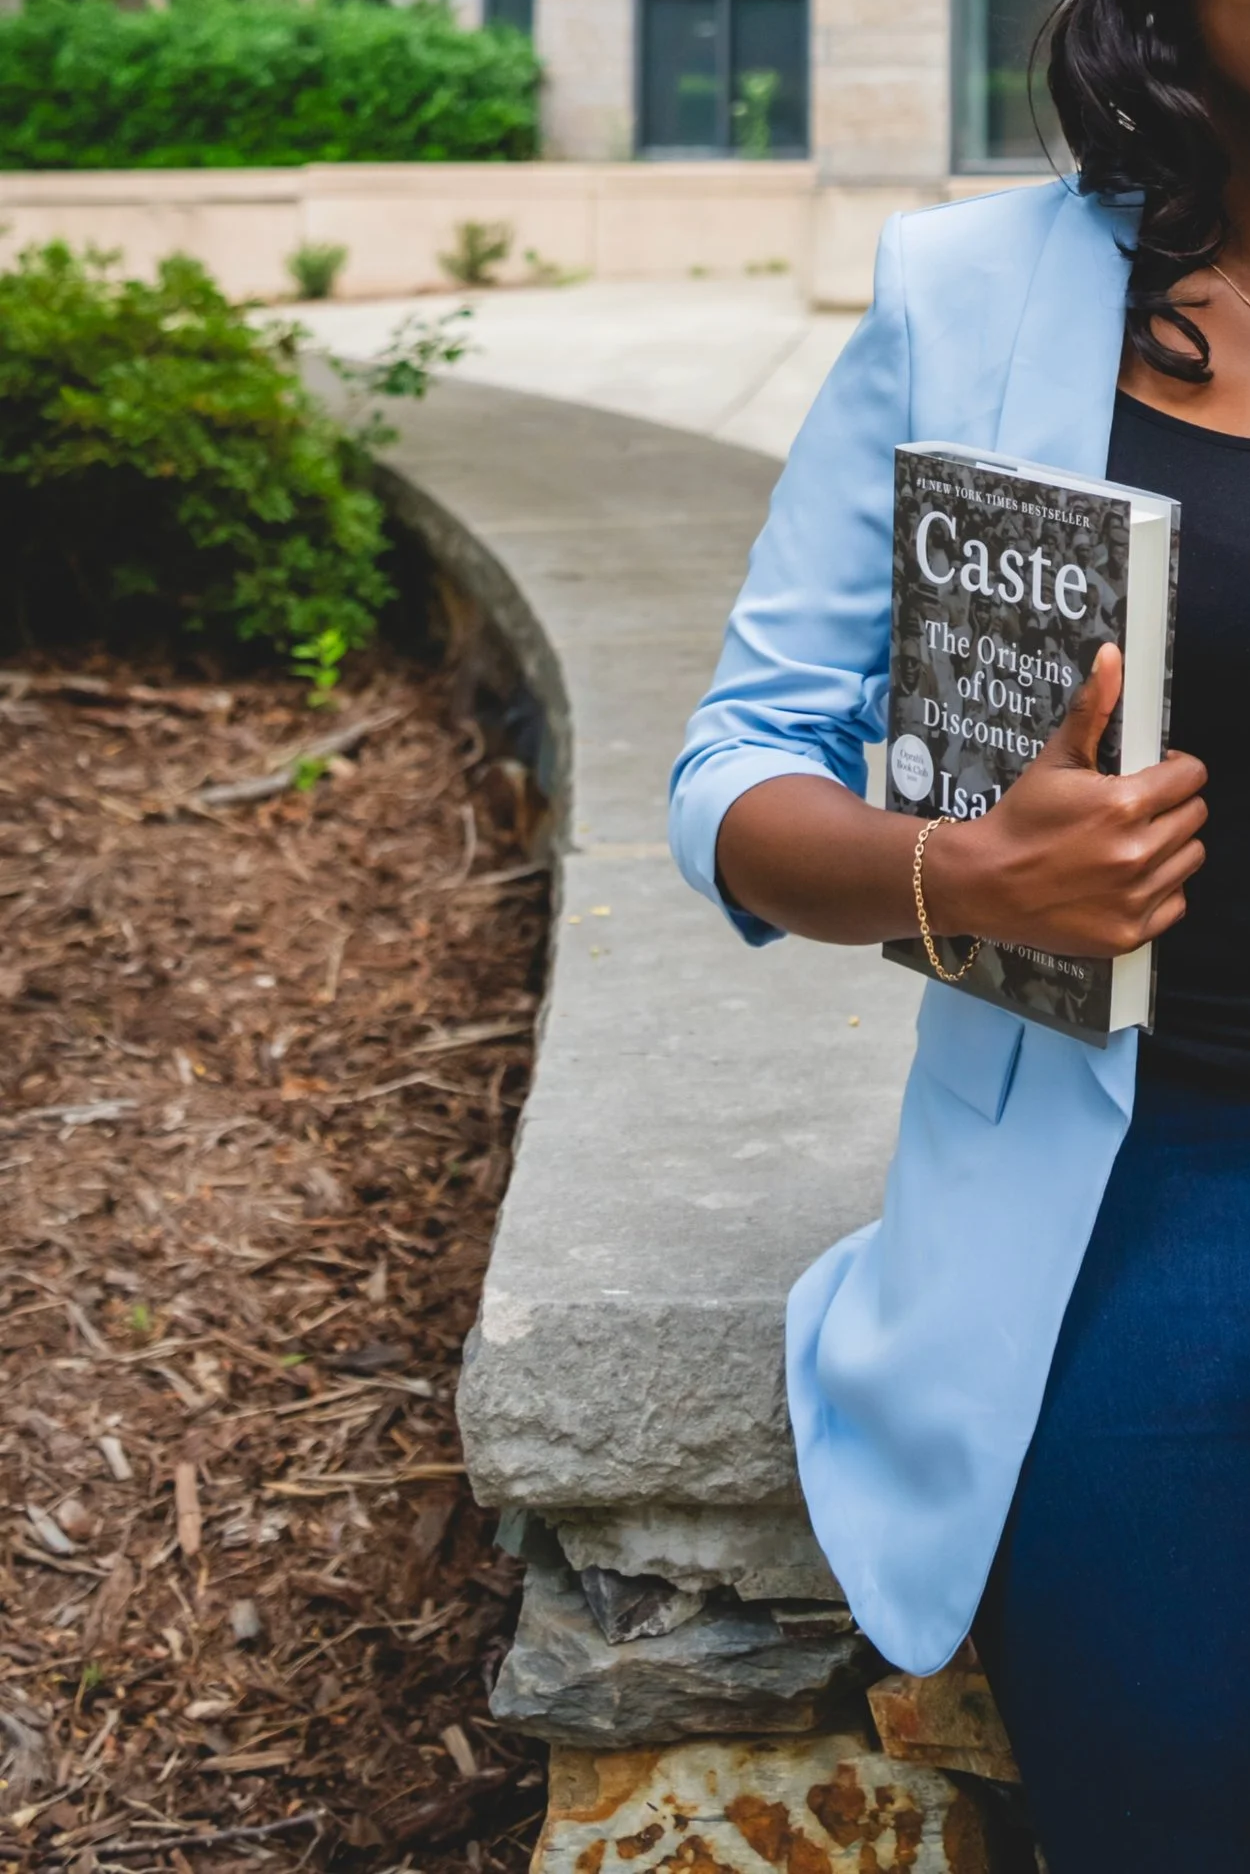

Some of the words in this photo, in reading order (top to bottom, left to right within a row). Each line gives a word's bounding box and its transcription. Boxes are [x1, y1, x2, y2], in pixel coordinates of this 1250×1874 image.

[928, 479, 951, 496] NEW
[954, 486, 982, 503] YORK
[985, 493, 1018, 512] TIMES
[1021, 501, 1090, 529] BESTSELLER
[916, 511, 1088, 620] Caste
[925, 620, 970, 658] The
[977, 635, 1073, 688] Origins
[957, 671, 985, 702] of
[988, 678, 1036, 718] Our
[923, 697, 1045, 760] Disconten
[1018, 946, 1054, 968] OTHER
[1057, 960, 1084, 979] SUNS
